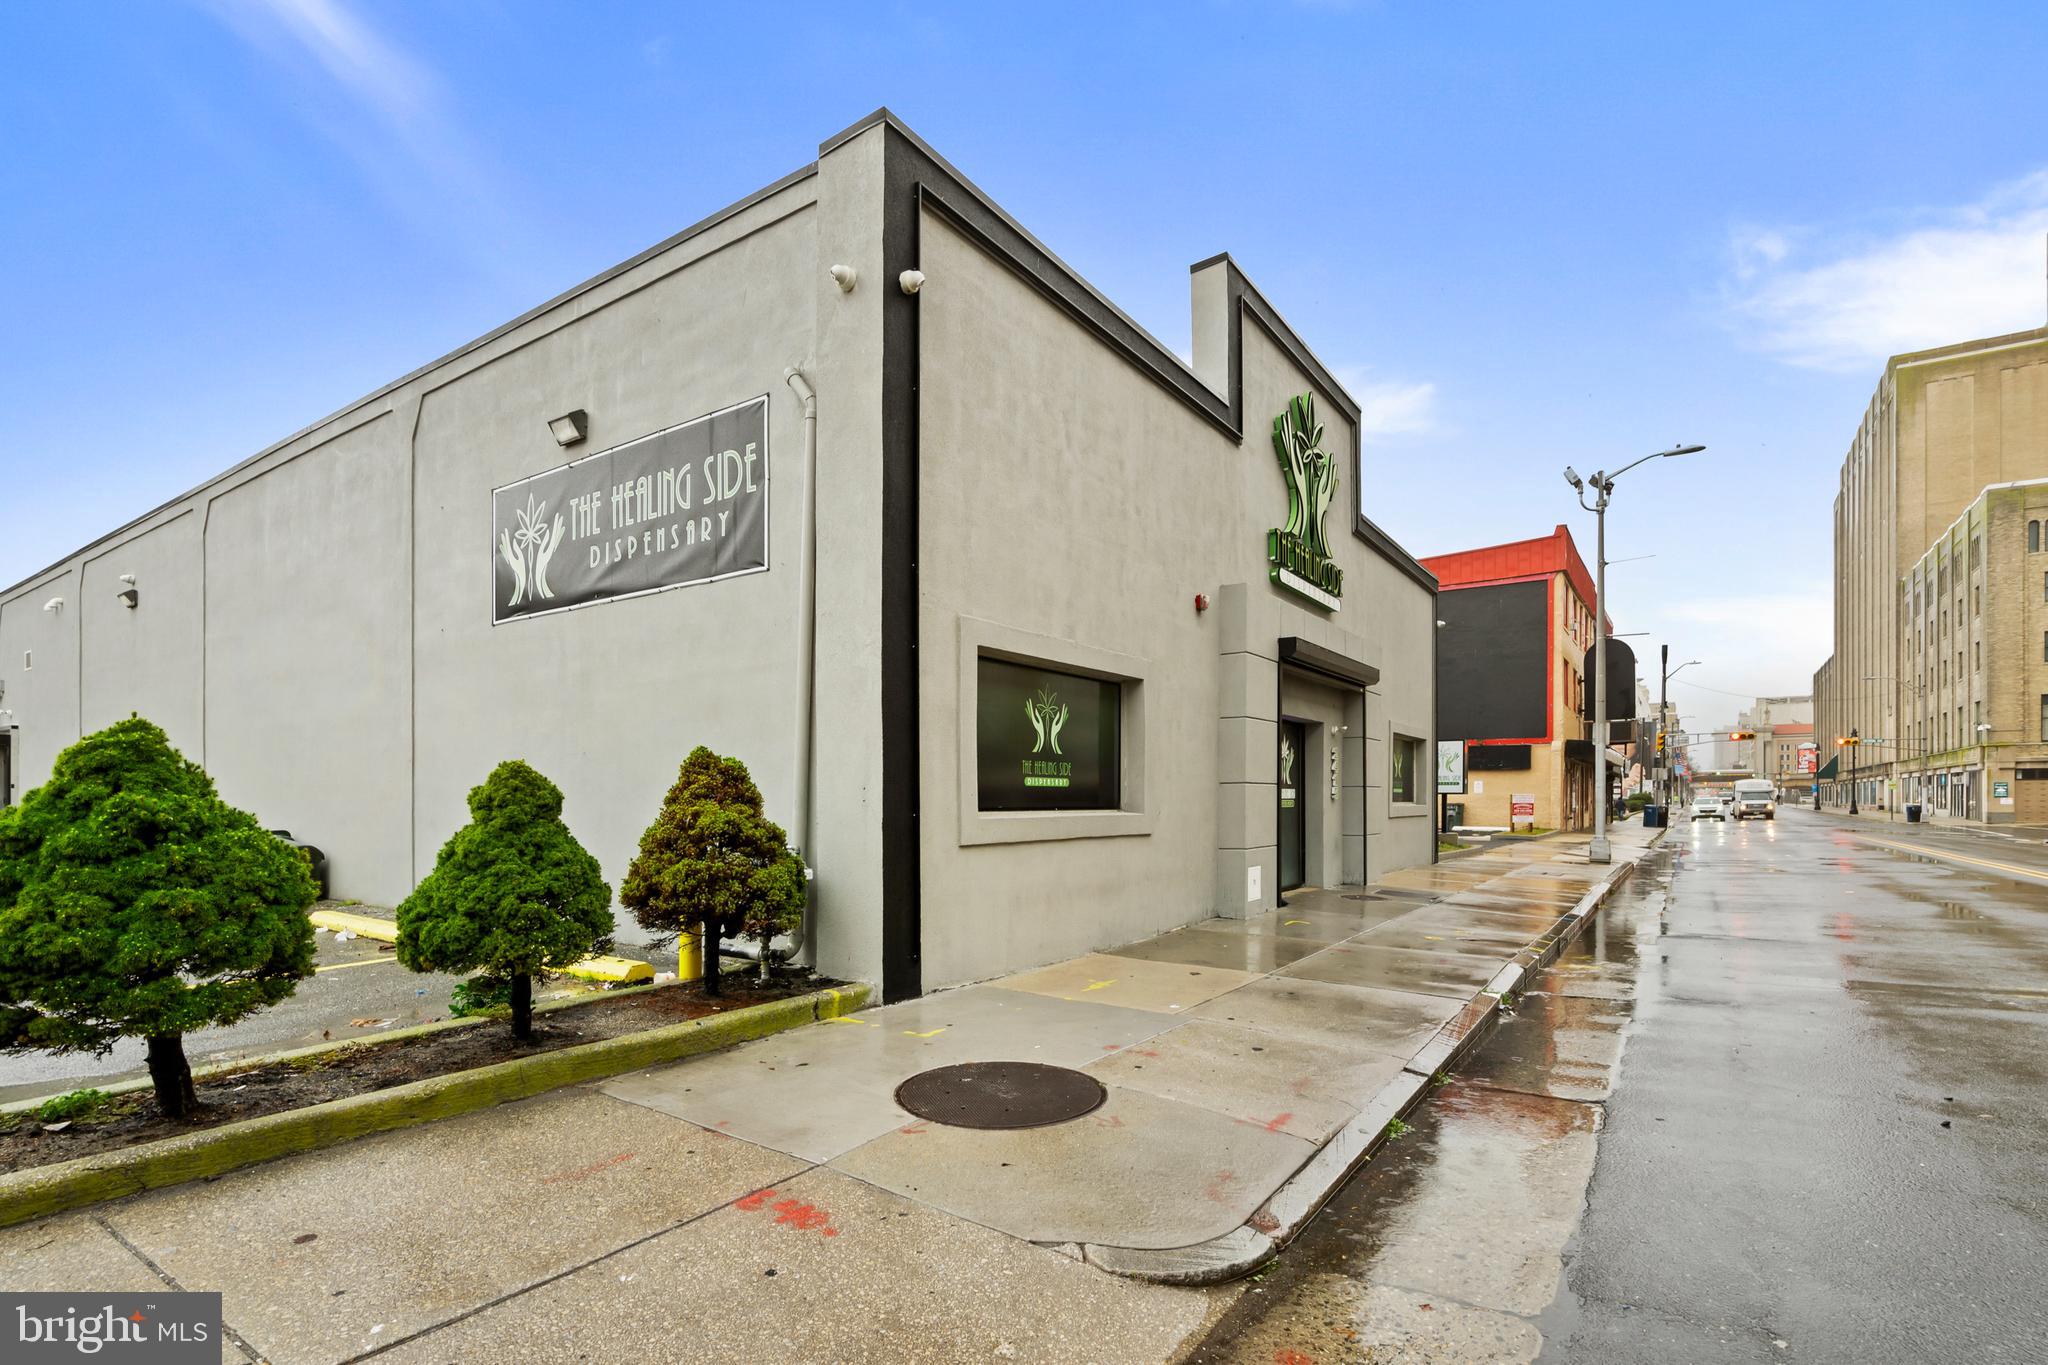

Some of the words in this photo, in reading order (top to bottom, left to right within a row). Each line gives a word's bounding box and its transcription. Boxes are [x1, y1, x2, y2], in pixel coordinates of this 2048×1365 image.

[569, 491, 601, 541] THE
[611, 463, 691, 530] HEALING
[703, 442, 757, 505] SIDE
[590, 510, 729, 568] DISPENSARY
[1022, 760, 1032, 775] THE
[1060, 762, 1072, 776] SIDE
